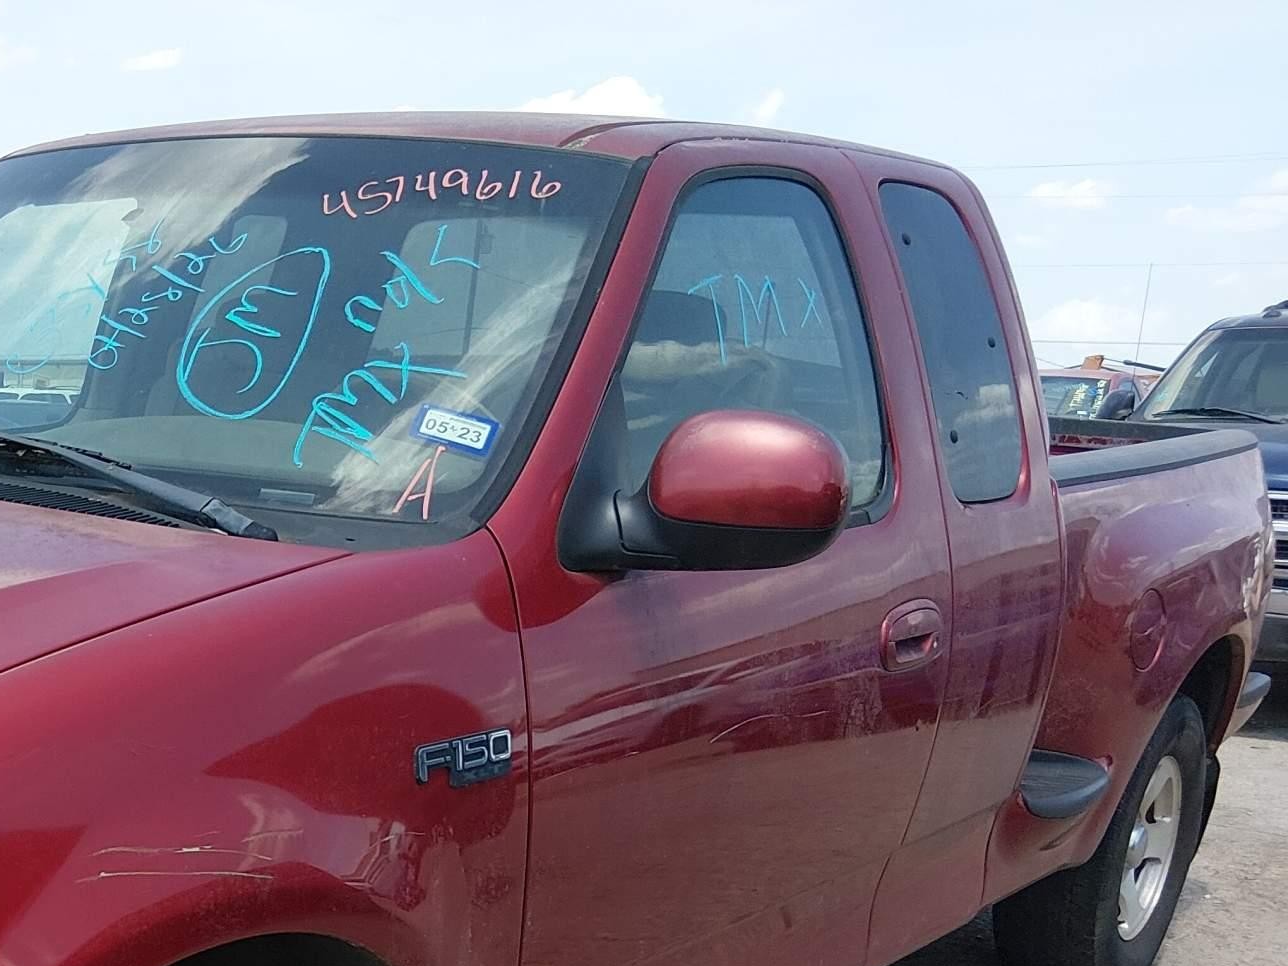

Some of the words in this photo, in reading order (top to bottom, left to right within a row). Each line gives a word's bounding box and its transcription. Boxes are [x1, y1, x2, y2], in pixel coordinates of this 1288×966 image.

[322, 167, 563, 219] 45749616
[687, 273, 825, 369] TMX
[425, 418, 448, 435] 05
[457, 426, 483, 444] 23
[391, 445, 447, 521] A
[417, 729, 512, 783] F-150
